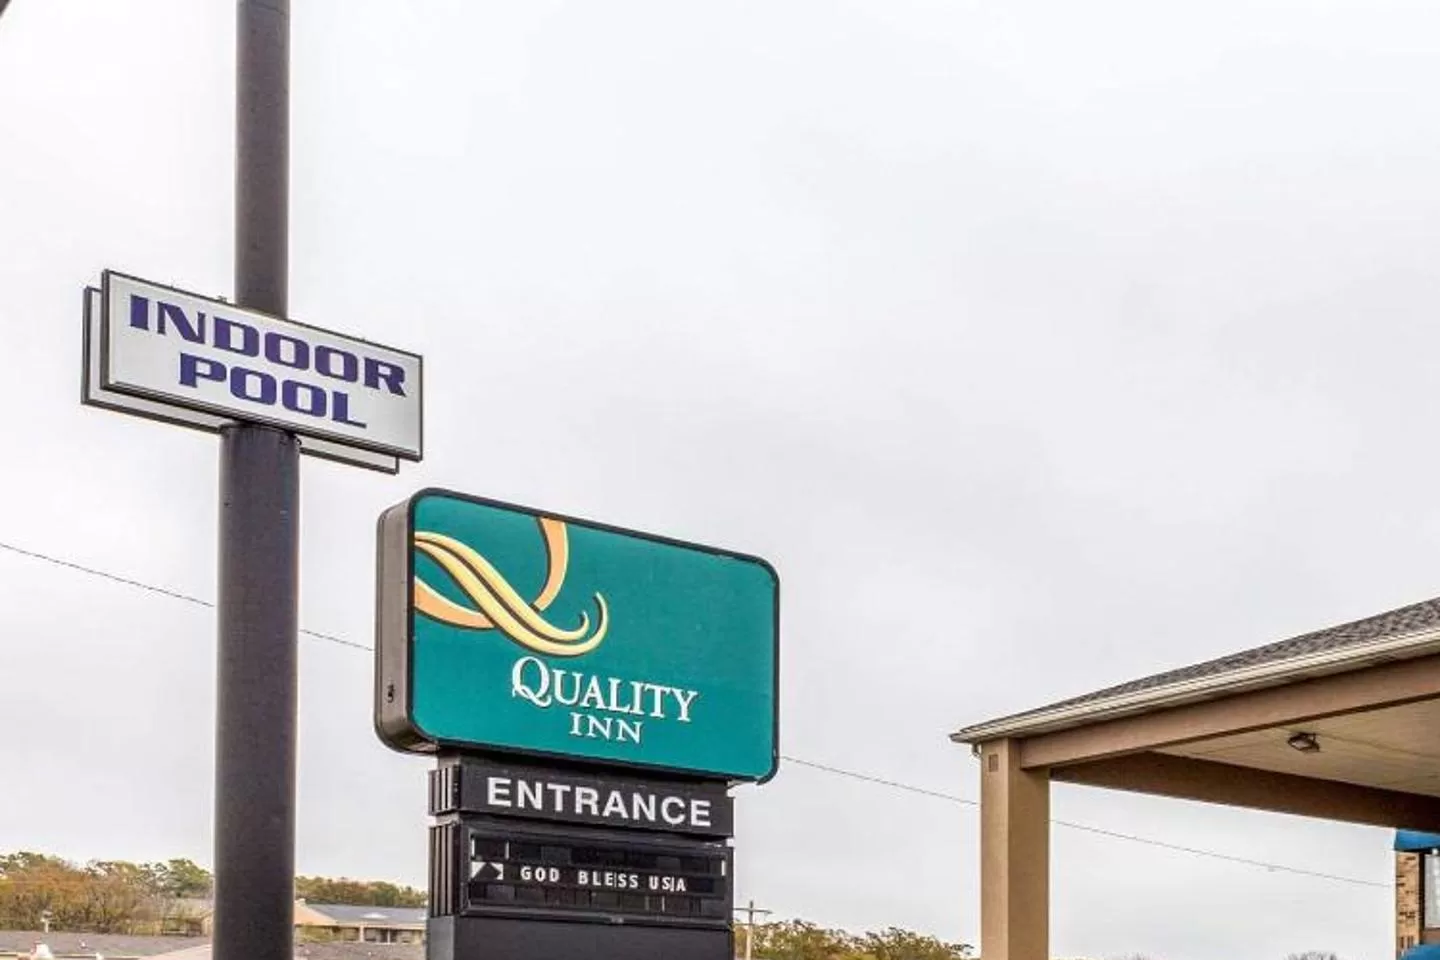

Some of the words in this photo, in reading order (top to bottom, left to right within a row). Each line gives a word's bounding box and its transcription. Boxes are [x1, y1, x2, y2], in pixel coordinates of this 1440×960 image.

[130, 293, 407, 397] INDOOR
[179, 352, 367, 429] POOL
[511, 656, 698, 723] QUALITY
[569, 712, 643, 744] INN
[487, 776, 712, 827] ENTRANCE
[520, 865, 560, 882] GOD
[577, 869, 639, 889] BLESS
[649, 875, 686, 893] USA
